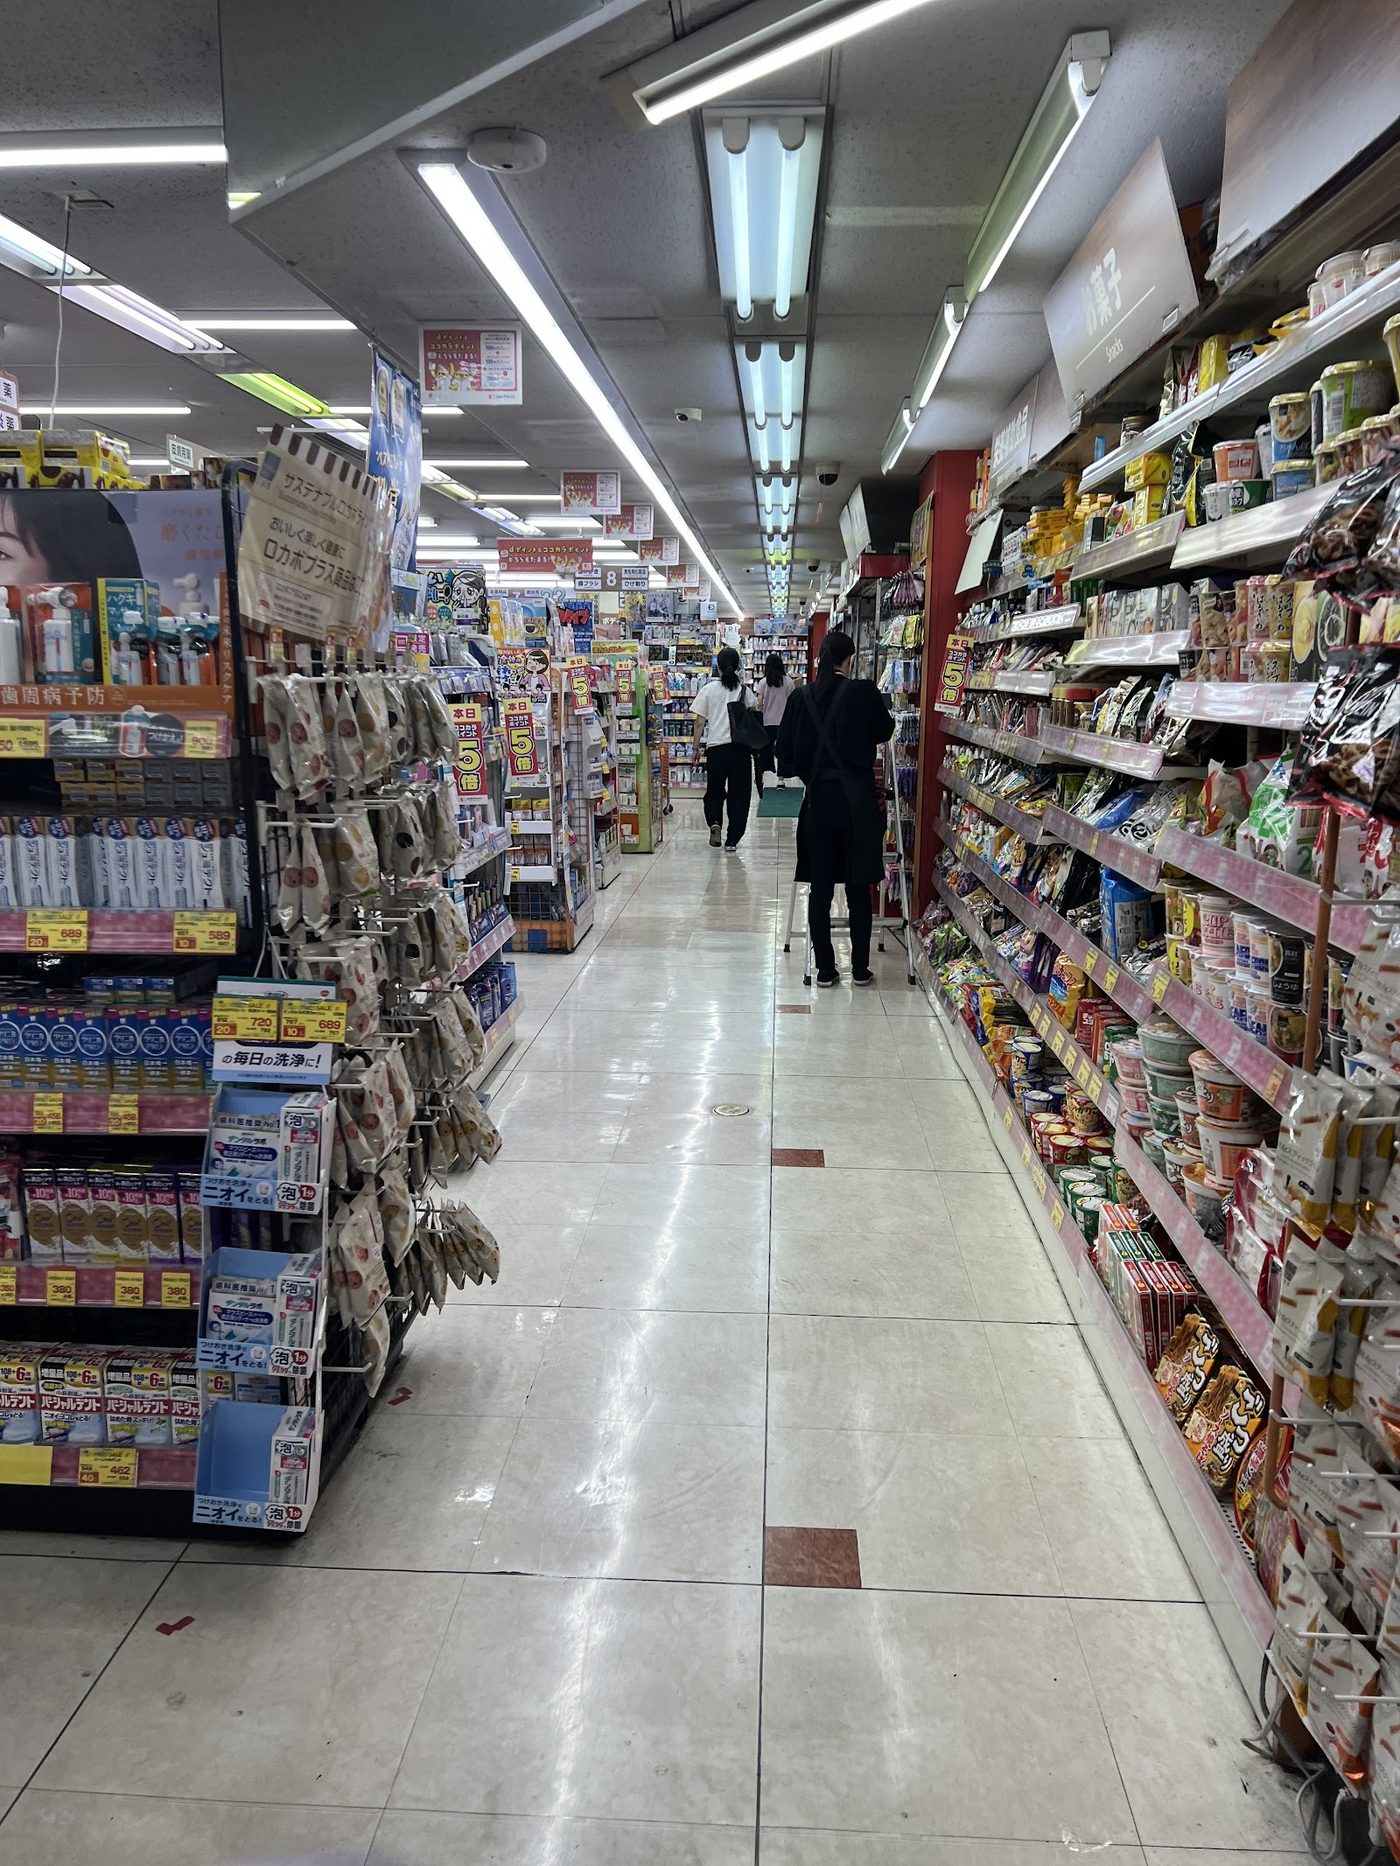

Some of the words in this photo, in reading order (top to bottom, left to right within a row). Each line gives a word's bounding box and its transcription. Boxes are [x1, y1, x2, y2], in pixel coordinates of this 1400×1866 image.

[1080, 247, 1121, 336] お菓子
[1105, 338, 1124, 364] Snacks
[605, 570, 617, 587] 8
[951, 638, 969, 648] 本日
[570, 658, 583, 666] 本日
[1, 686, 105, 706] 歯周病予防
[571, 677, 589, 706] 5倍
[508, 702, 527, 711] 本日
[453, 708, 476, 718] 本日
[510, 728, 534, 772] 5倍
[455, 740, 482, 792] 5倍
[61, 928, 82, 938] 689
[208, 930, 231, 940] 589
[1273, 981, 1299, 991] しょうゆ
[250, 1017, 272, 1026] 720
[319, 1020, 341, 1029] 689
[216, 1025, 230, 1034] 20
[222, 1051, 322, 1069] の毎日の洗浄に!
[281, 1186, 296, 1200] 泡
[301, 1187, 314, 1199] 1分
[52, 1285, 72, 1293] 380
[120, 1286, 139, 1294] 380
[167, 1287, 186, 1295] 380
[275, 1352, 289, 1365] 泡
[293, 1351, 306, 1362] 1分
[110, 1466, 131, 1475] 462
[269, 1507, 283, 1520] 泡
[288, 1508, 301, 1517] 1分
